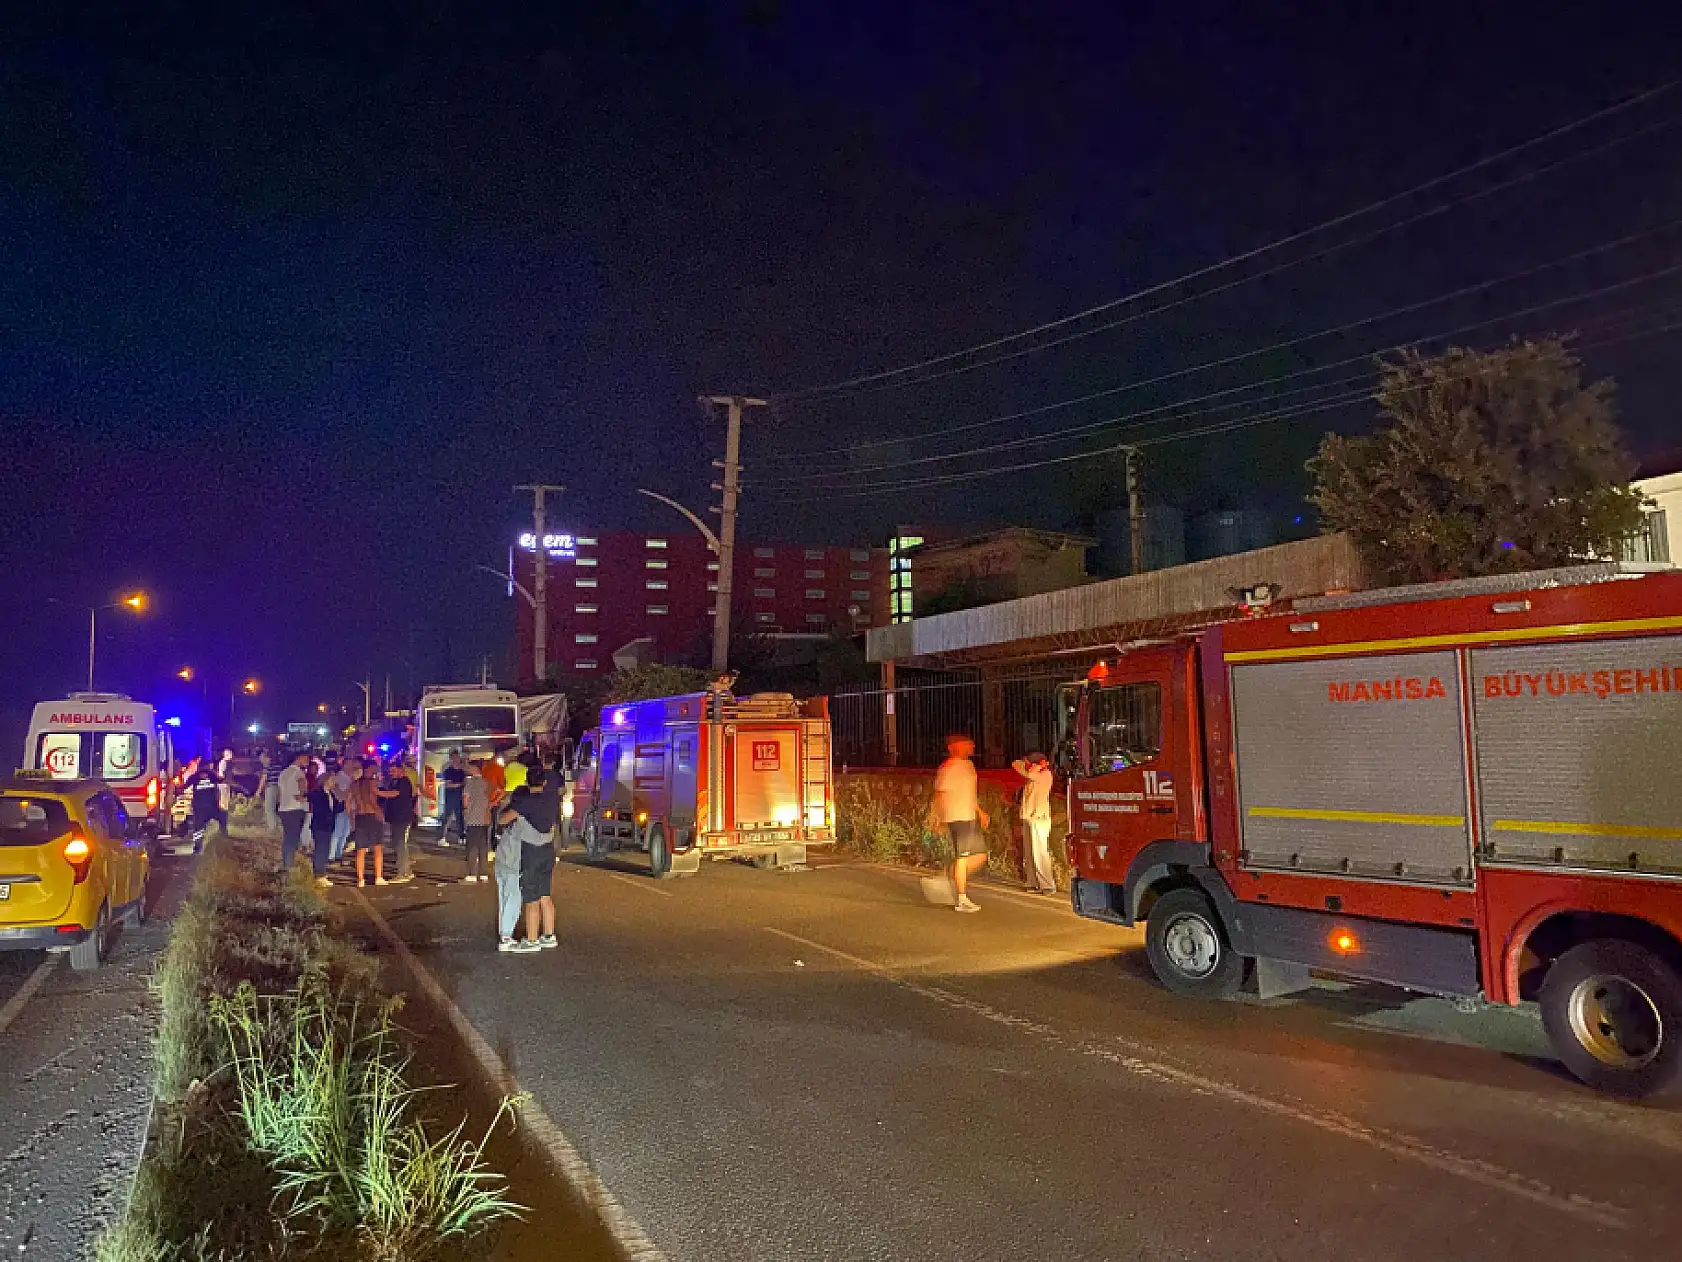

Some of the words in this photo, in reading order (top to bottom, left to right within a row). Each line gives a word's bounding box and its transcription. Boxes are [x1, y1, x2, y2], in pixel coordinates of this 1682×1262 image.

[1328, 675, 1446, 702] MANİSA
[48, 713, 134, 724] AMBULANS
[756, 744, 776, 759] 112
[52, 753, 75, 767] 112
[1142, 770, 1173, 794] 112
